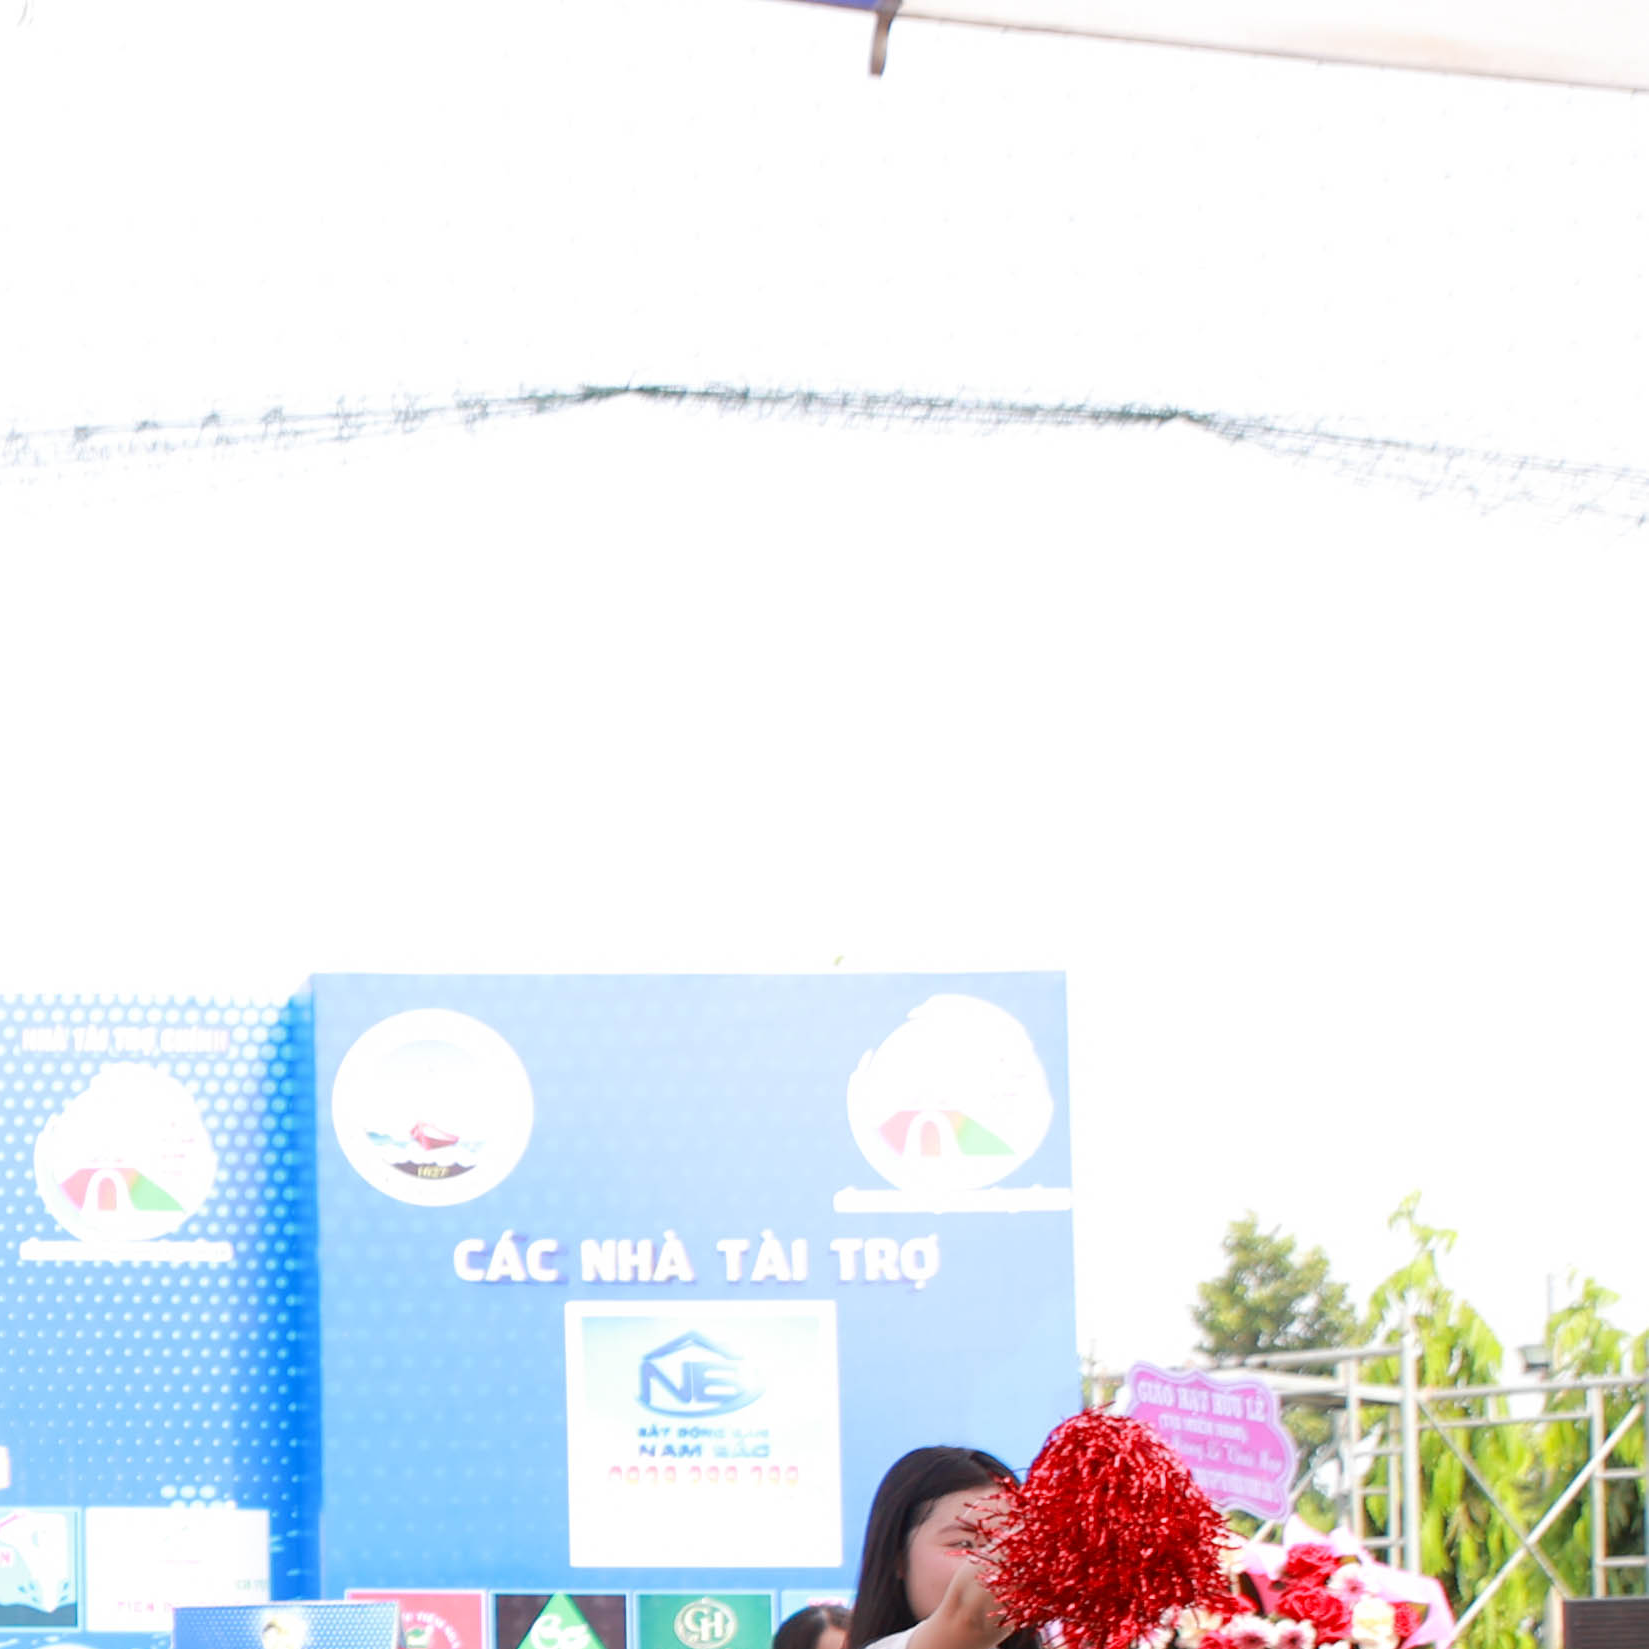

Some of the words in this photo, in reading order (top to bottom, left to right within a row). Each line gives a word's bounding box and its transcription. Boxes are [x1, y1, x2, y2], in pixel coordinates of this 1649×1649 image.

[454, 1231, 558, 1283] CÁC
[582, 1230, 694, 1283] NHÀ
[717, 1230, 807, 1283] TÀI
[830, 1233, 940, 1290] TRỢ
